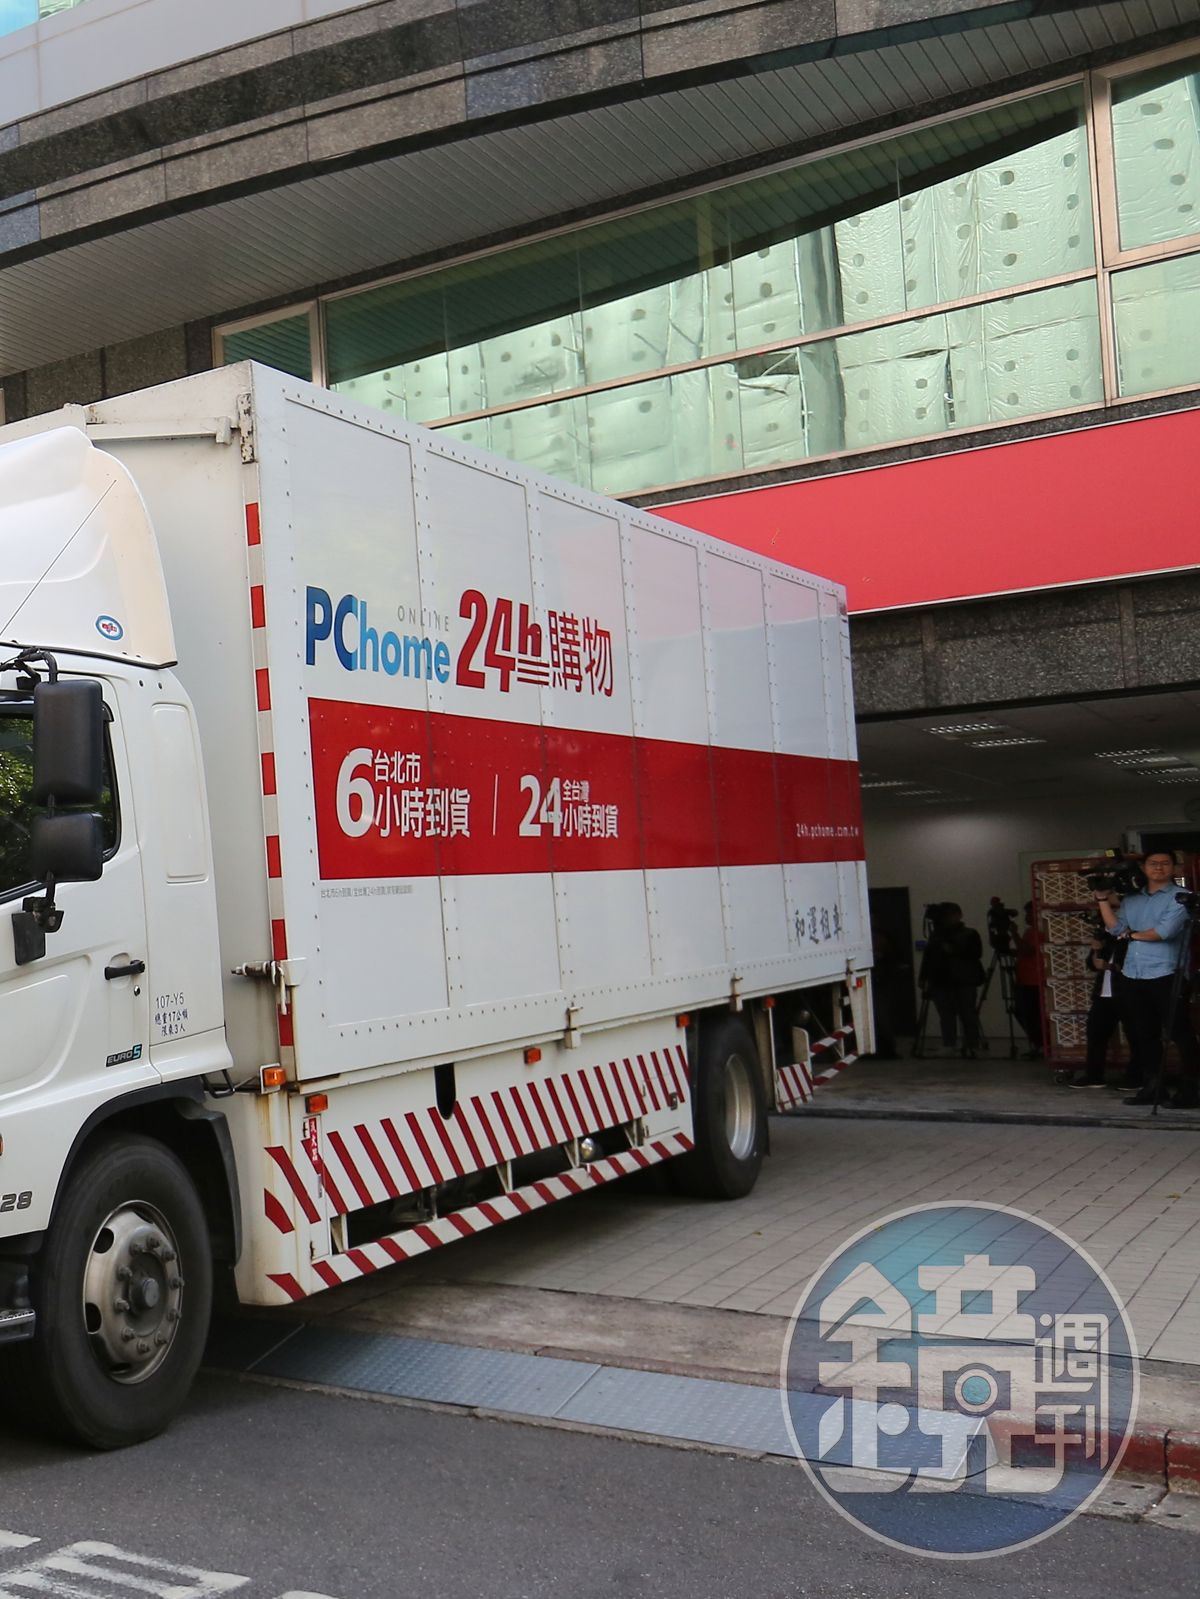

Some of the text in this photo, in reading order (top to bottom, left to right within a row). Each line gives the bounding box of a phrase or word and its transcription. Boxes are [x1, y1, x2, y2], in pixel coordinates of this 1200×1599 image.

[397, 605, 449, 632] ONLINE
[306, 586, 451, 684] PChome
[374, 750, 421, 784] 台北市
[336, 747, 471, 838] 6 小時到貨
[519, 775, 619, 838] 24 小時到貨
[562, 780, 590, 803] 全台灣
[795, 823, 859, 840] 24h.pchome.com.tw
[155, 992, 185, 1009] 107-Y5
